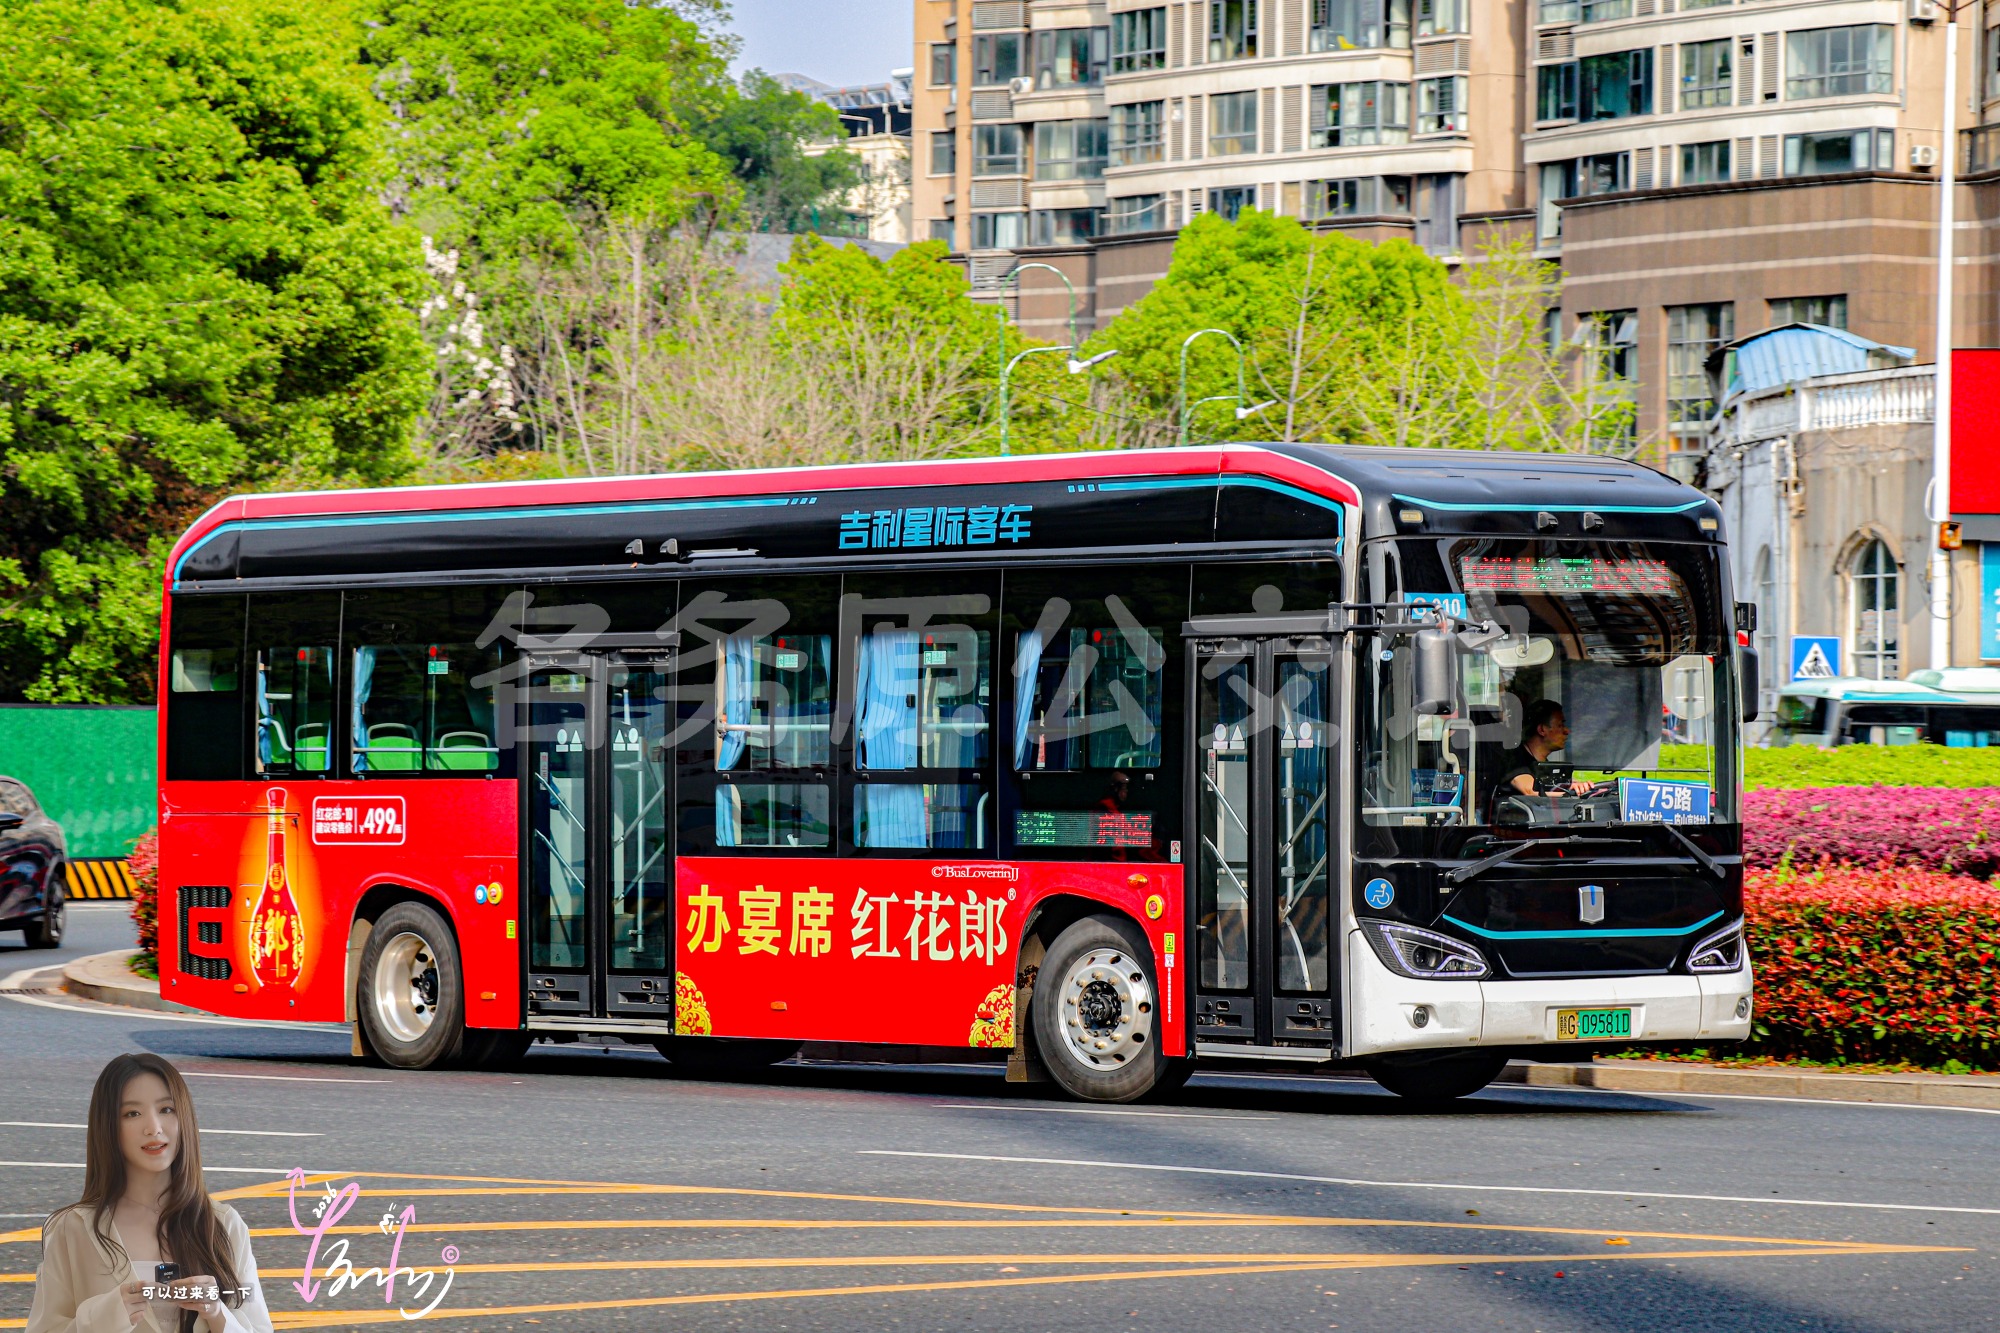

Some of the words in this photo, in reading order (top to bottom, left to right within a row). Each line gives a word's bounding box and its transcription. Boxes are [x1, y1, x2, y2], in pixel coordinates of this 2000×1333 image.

[838, 503, 1033, 549] 吉利星际客车
[1647, 785, 1692, 812] 75路
[686, 884, 834, 957] 办宴席
